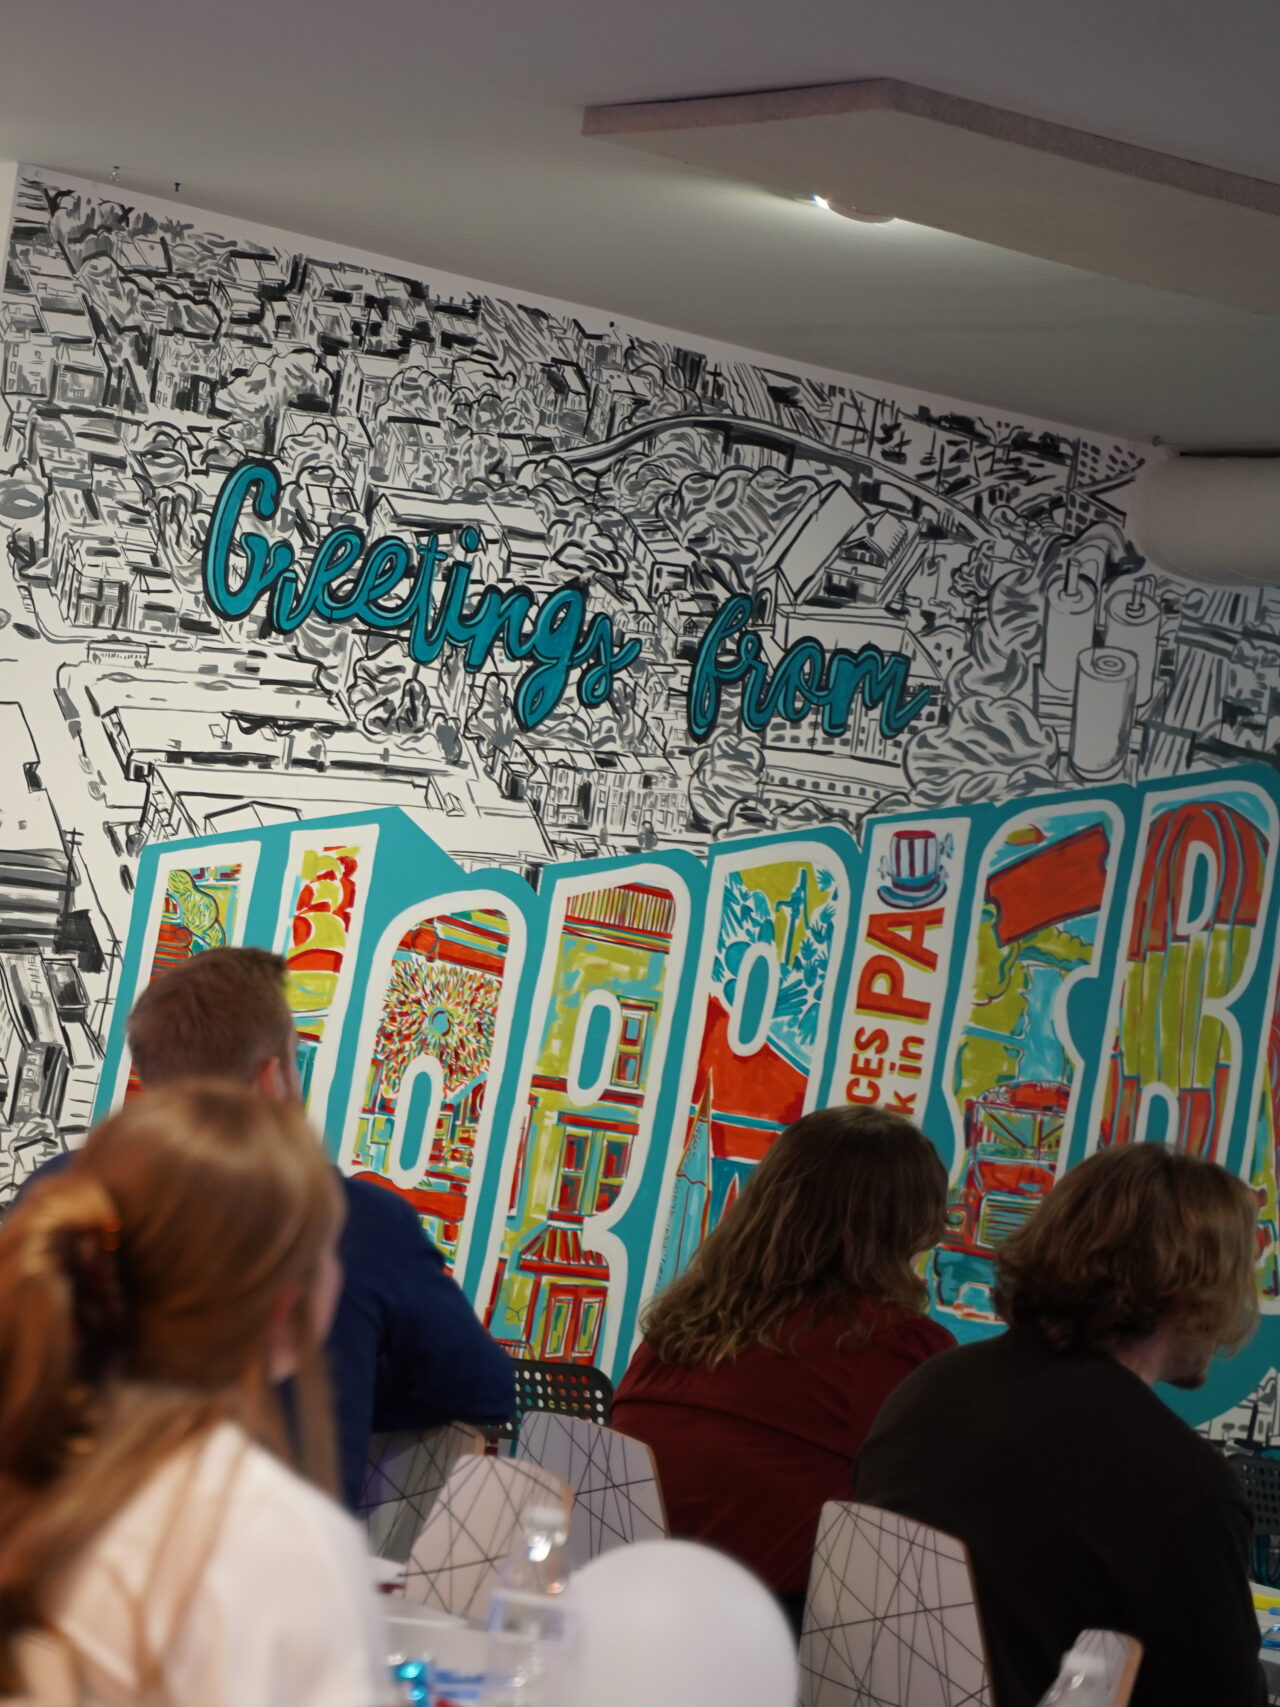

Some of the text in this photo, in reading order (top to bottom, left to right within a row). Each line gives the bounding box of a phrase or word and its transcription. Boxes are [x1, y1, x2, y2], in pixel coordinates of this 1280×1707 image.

[202, 457, 930, 743] Greetings from
[854, 906, 946, 1026] PA
[887, 1035, 926, 1080] in
